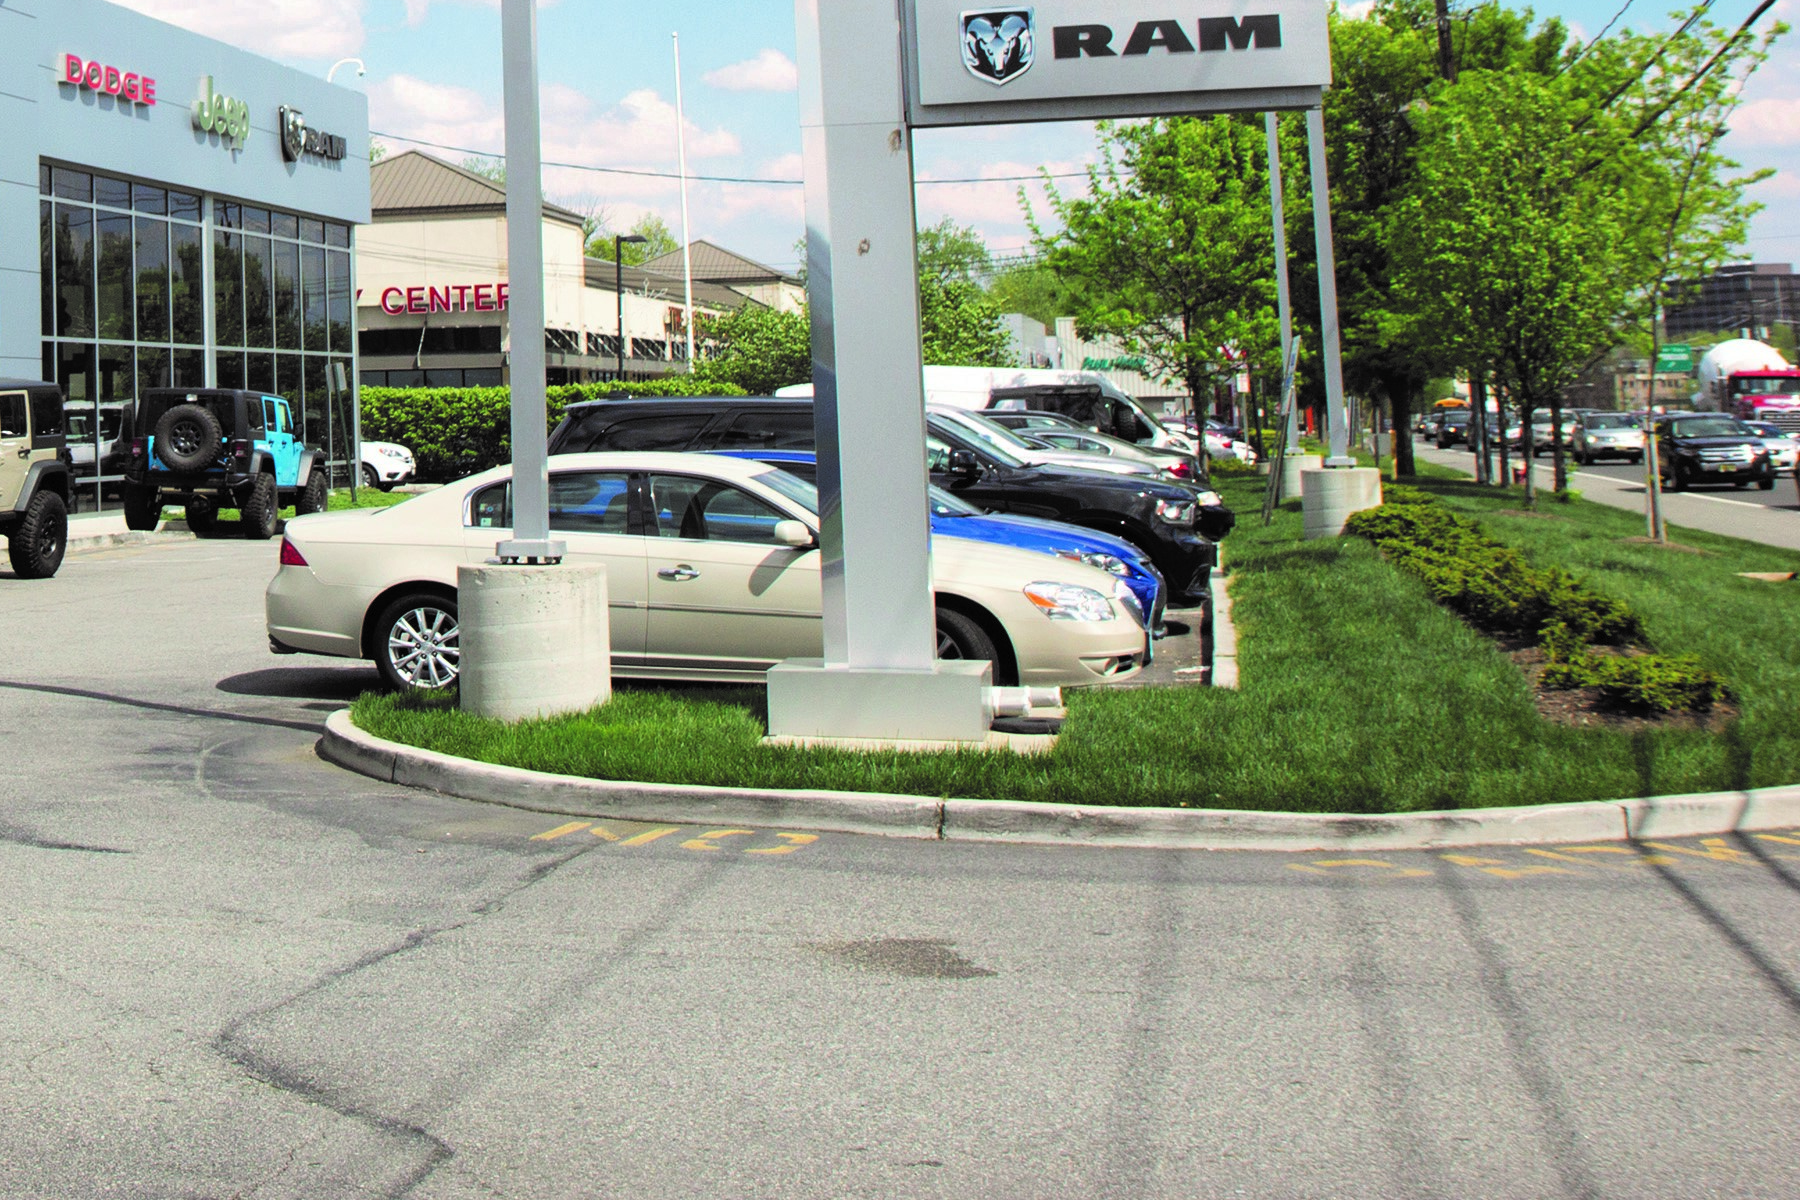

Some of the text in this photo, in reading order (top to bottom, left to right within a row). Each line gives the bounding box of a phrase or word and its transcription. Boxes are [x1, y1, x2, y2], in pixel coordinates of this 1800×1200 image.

[1052, 14, 1282, 60] RAM
[60, 52, 156, 105] DODGE
[192, 75, 249, 150] Jeep
[303, 127, 346, 160] RAM
